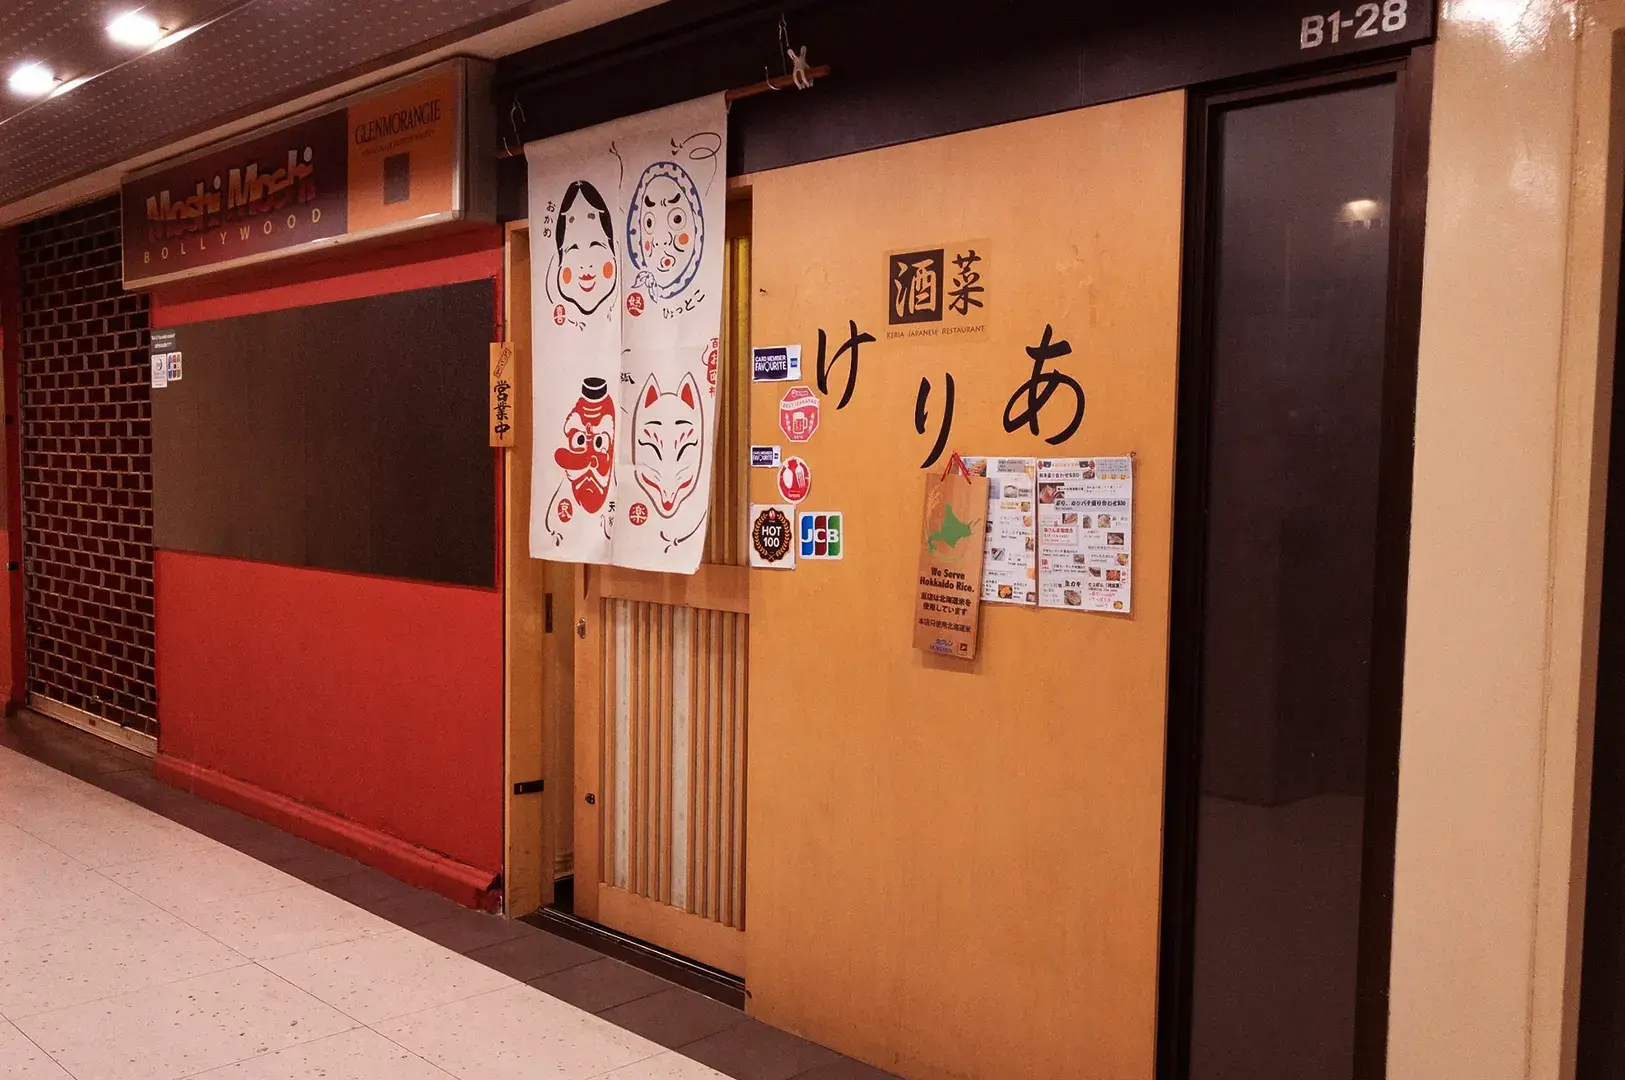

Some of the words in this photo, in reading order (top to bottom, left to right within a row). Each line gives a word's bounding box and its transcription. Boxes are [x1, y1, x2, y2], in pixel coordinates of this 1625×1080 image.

[1300, 0, 1408, 50] B1-28
[355, 99, 441, 145] GLENMORANGIE
[146, 174, 221, 221] Moshi
[228, 146, 314, 210] Moshi
[543, 201, 557, 238] おかめ
[144, 208, 322, 264] BOLLYWOOD
[894, 249, 986, 319] 酒菜
[662, 289, 706, 319] ひょっとこ
[908, 328, 940, 338] JAPANESE
[942, 325, 986, 335] RESTAURANT
[755, 361, 787, 372] FAVOURITE
[494, 380, 512, 440] 営業中
[630, 505, 648, 524] 楽
[762, 526, 782, 536] HOT
[801, 528, 840, 543] JCB
[763, 537, 780, 547] 100
[931, 567, 942, 577] We
[943, 568, 966, 580] Serve
[920, 576, 955, 590] Hokkaido
[956, 581, 975, 593] Rice.
[920, 592, 972, 607] 当店は北海道米を
[923, 602, 968, 616] 使用しています
